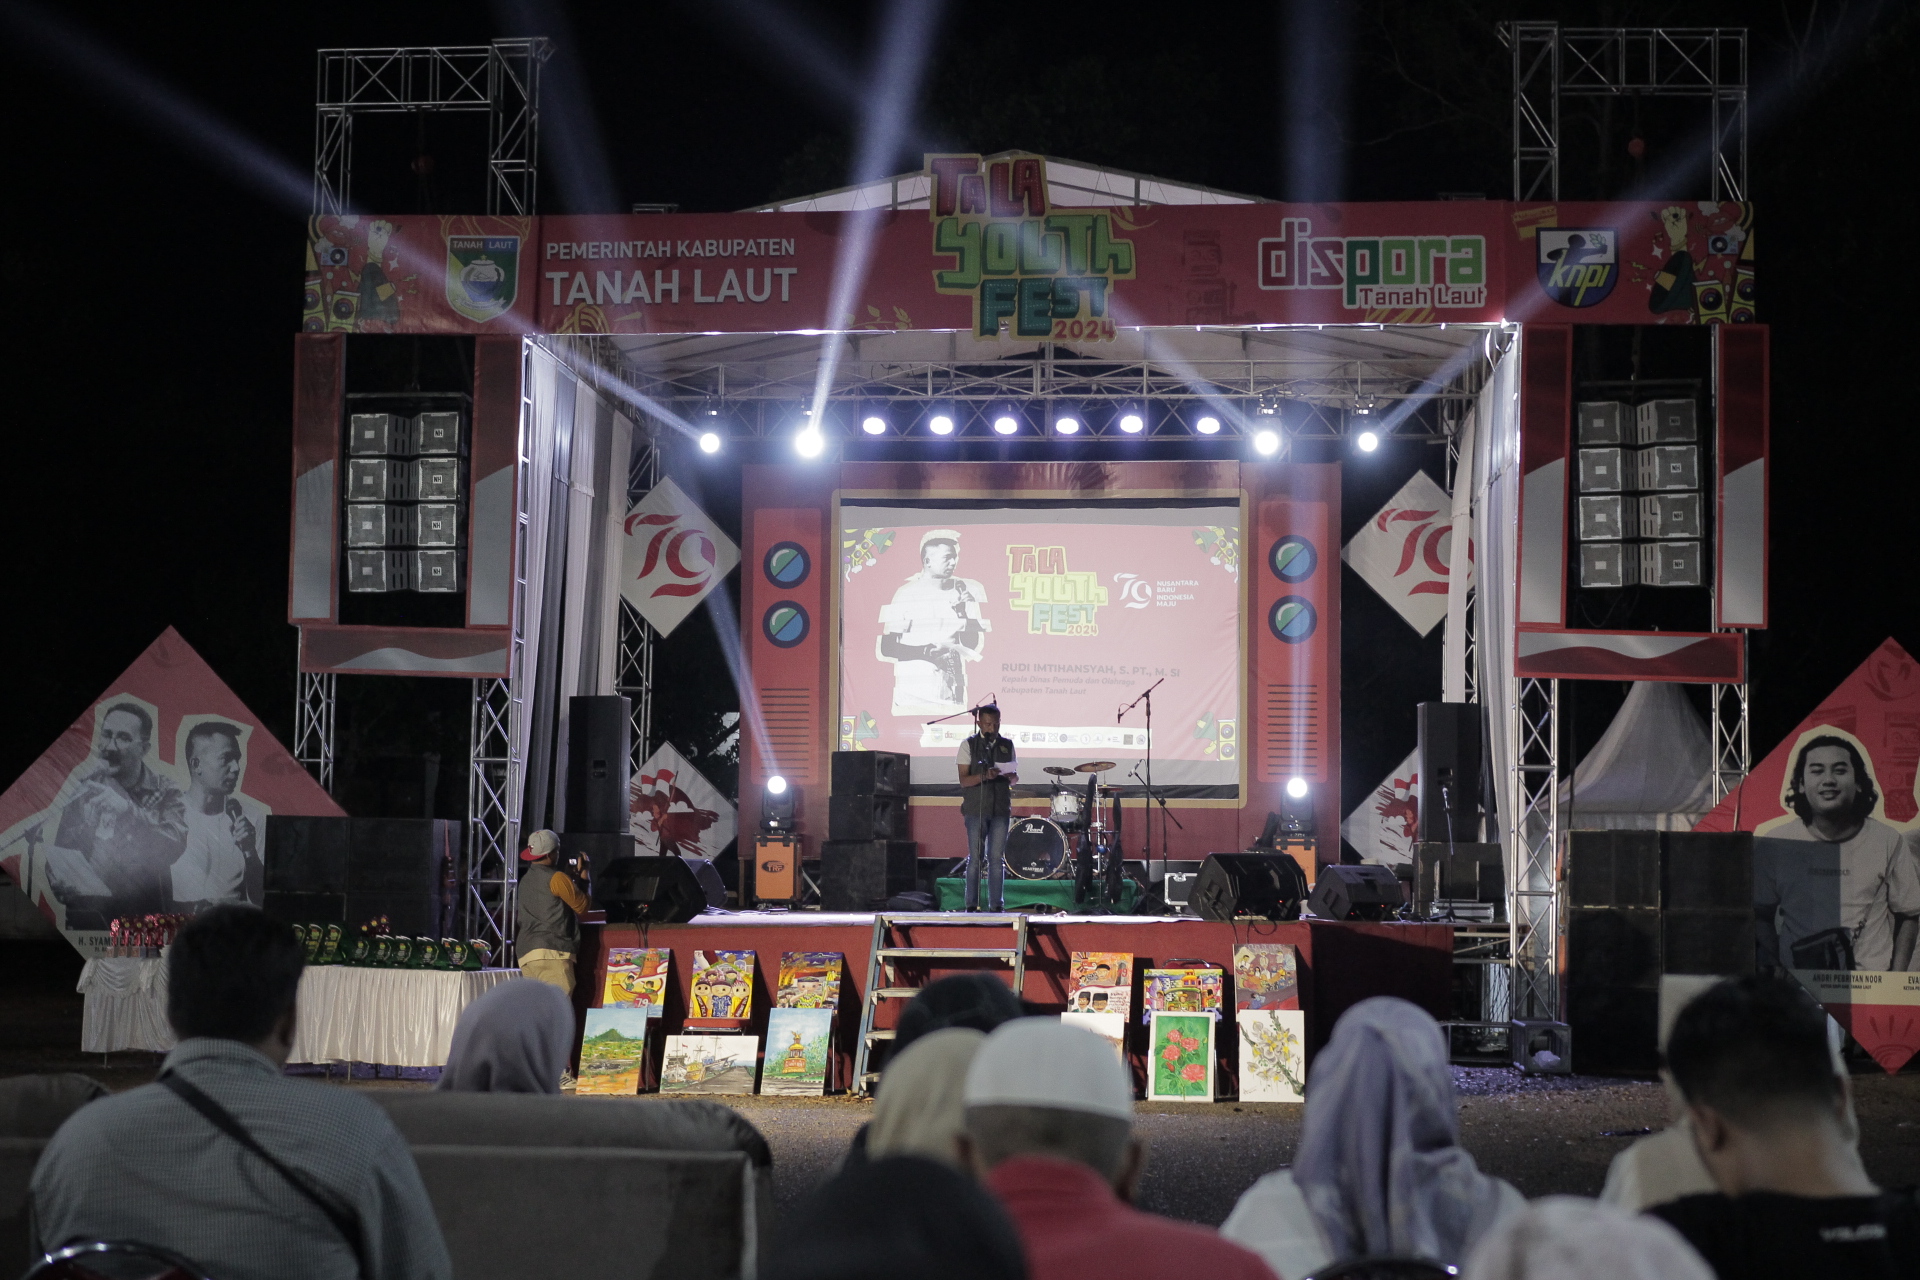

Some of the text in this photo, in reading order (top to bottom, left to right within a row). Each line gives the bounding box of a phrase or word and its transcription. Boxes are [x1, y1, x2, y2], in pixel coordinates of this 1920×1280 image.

[452, 240, 513, 249] TANAH LAUT
[546, 238, 796, 261] PEMERINTAH KABUPATEN
[545, 267, 798, 306] TANAH LAUT
[1358, 286, 1486, 307] Tanah Laut
[979, 277, 1109, 337] FEST
[1053, 319, 1116, 339] 2024
[1031, 603, 1095, 633] FEST
[1067, 624, 1098, 635] 2024
[1001, 663, 1030, 672] RUDI
[1033, 664, 1117, 675] IMTIHANSYAH,
[1119, 666, 1130, 675] S.
[1155, 668, 1168, 677] M.
[1170, 668, 1180, 677] SI
[1001, 676, 1136, 686] Kepala Dinas Pemuda dan Olahraga
[1001, 687, 1087, 696] Kabupaten Tanah Laut
[1022, 822, 1045, 834] Pearl
